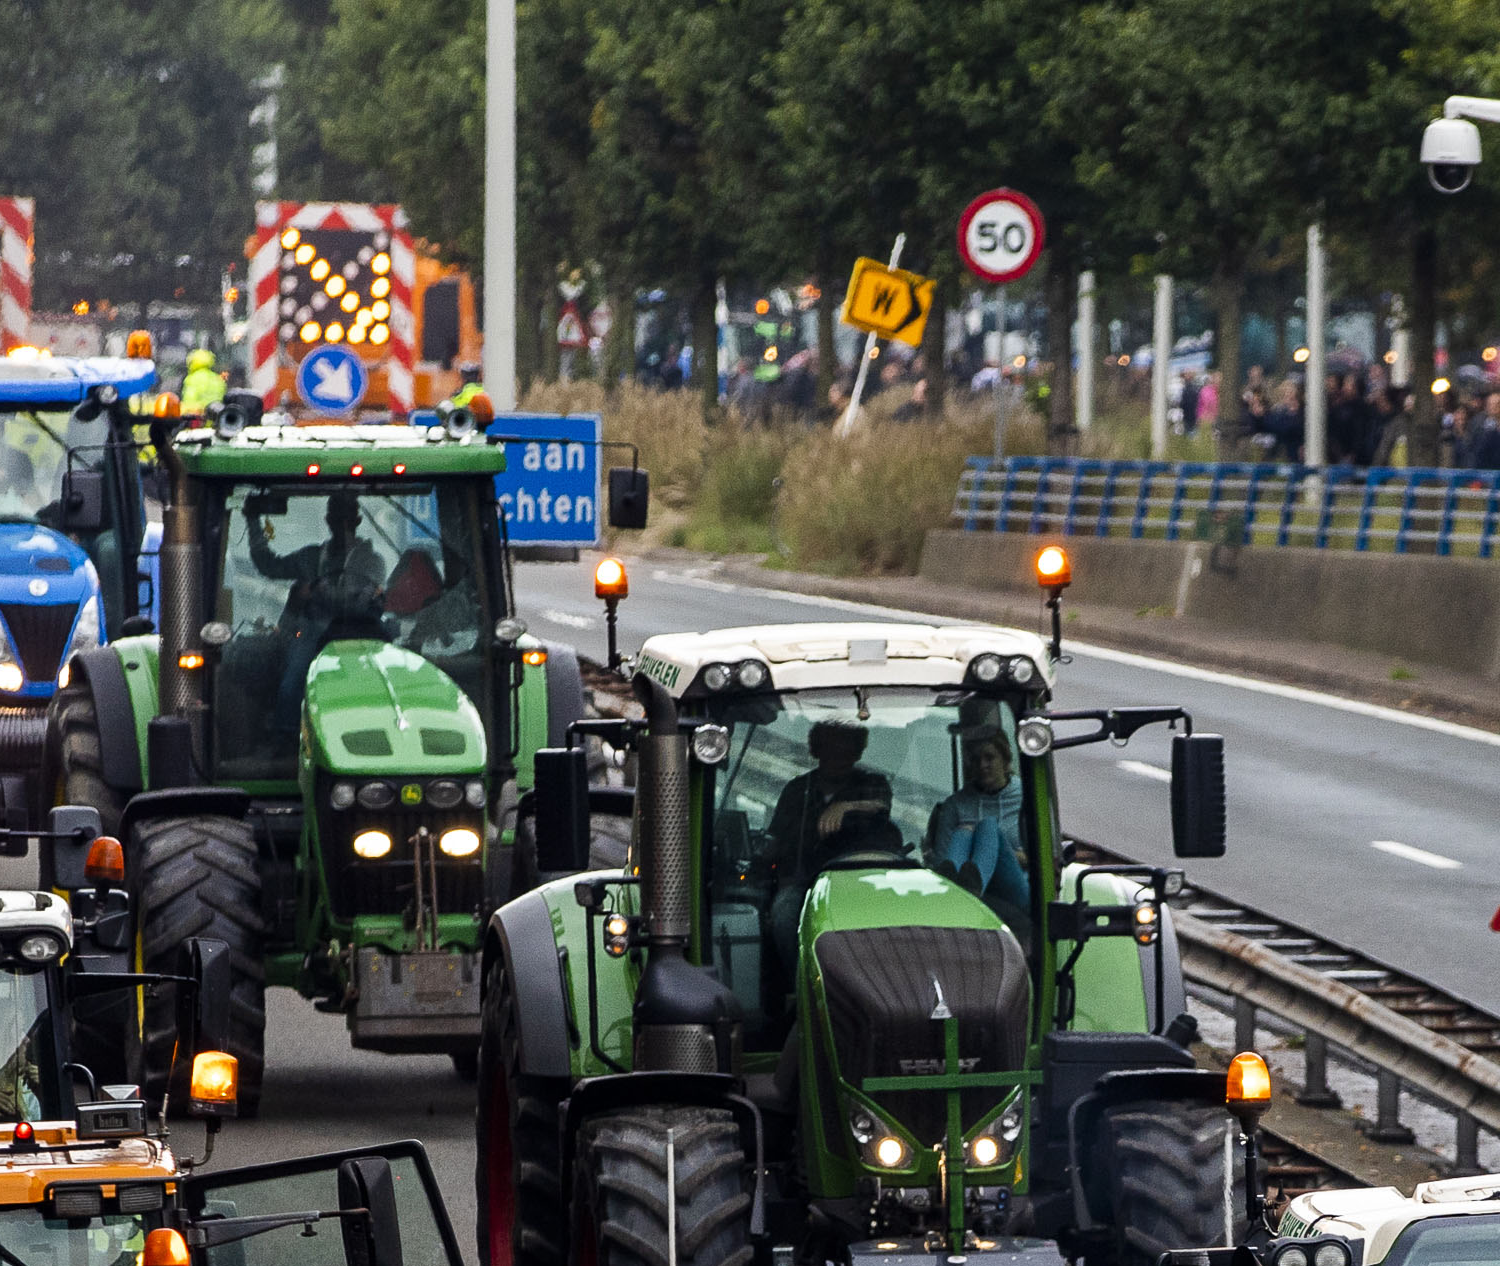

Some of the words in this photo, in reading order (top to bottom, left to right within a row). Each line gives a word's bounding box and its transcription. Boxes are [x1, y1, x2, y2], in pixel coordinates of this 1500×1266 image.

[977, 220, 1026, 253] 50
[522, 441, 586, 472] aan
[496, 487, 594, 523] chten
[899, 1057, 982, 1075] FENT
